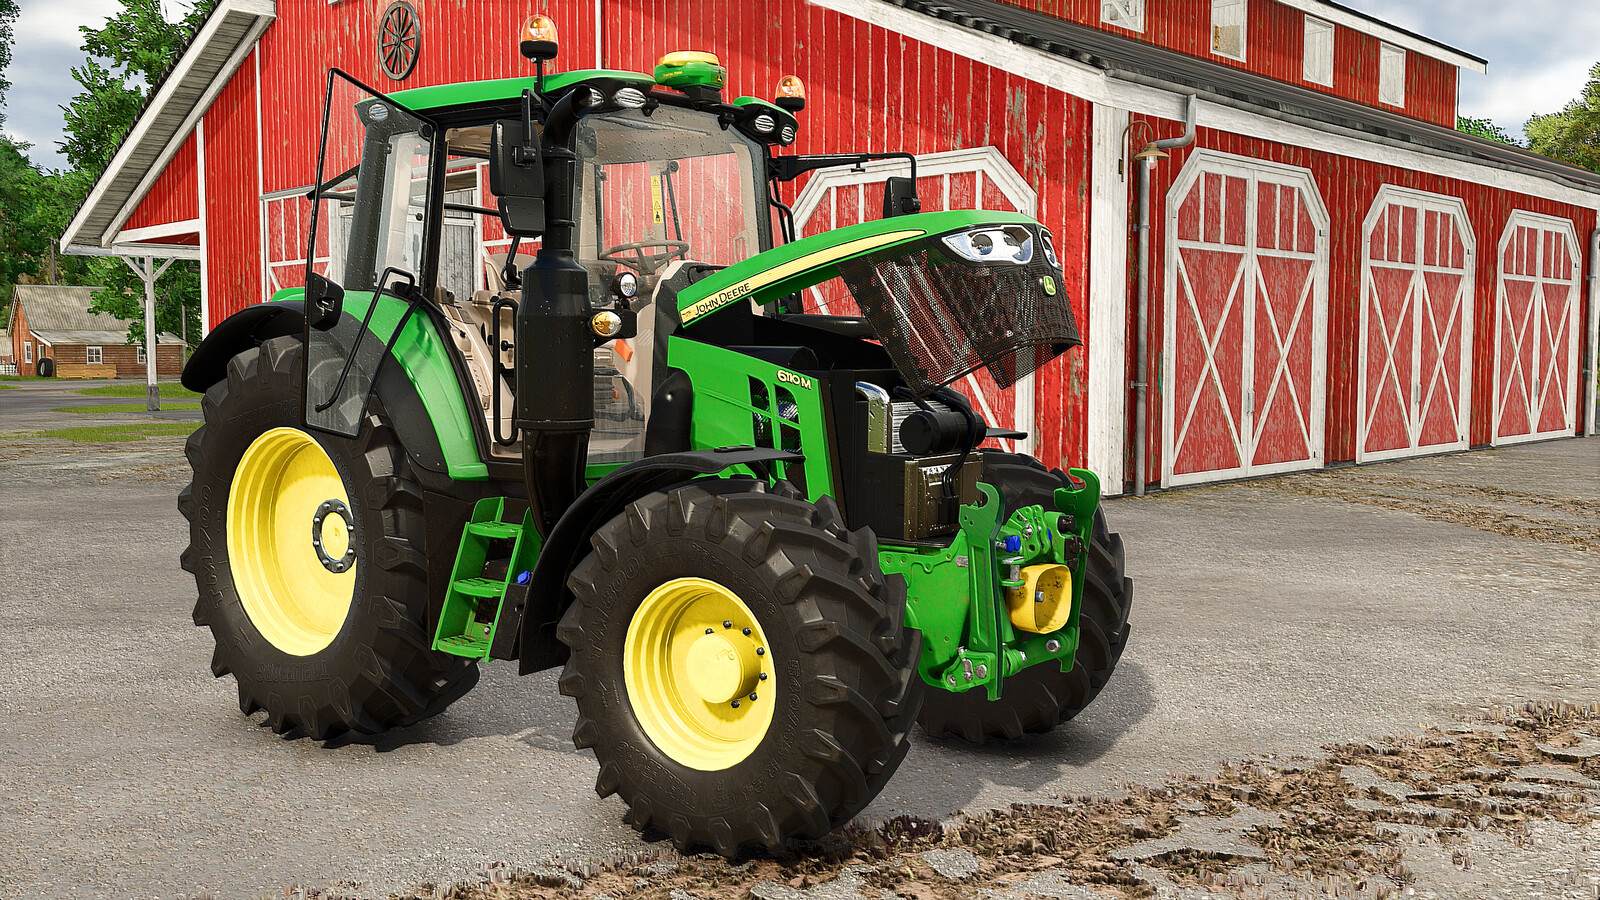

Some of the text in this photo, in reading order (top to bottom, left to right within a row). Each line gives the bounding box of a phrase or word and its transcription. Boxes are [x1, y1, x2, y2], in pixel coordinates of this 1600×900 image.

[695, 282, 751, 316] JOHN DEERE
[777, 369, 812, 390] 6110 M
